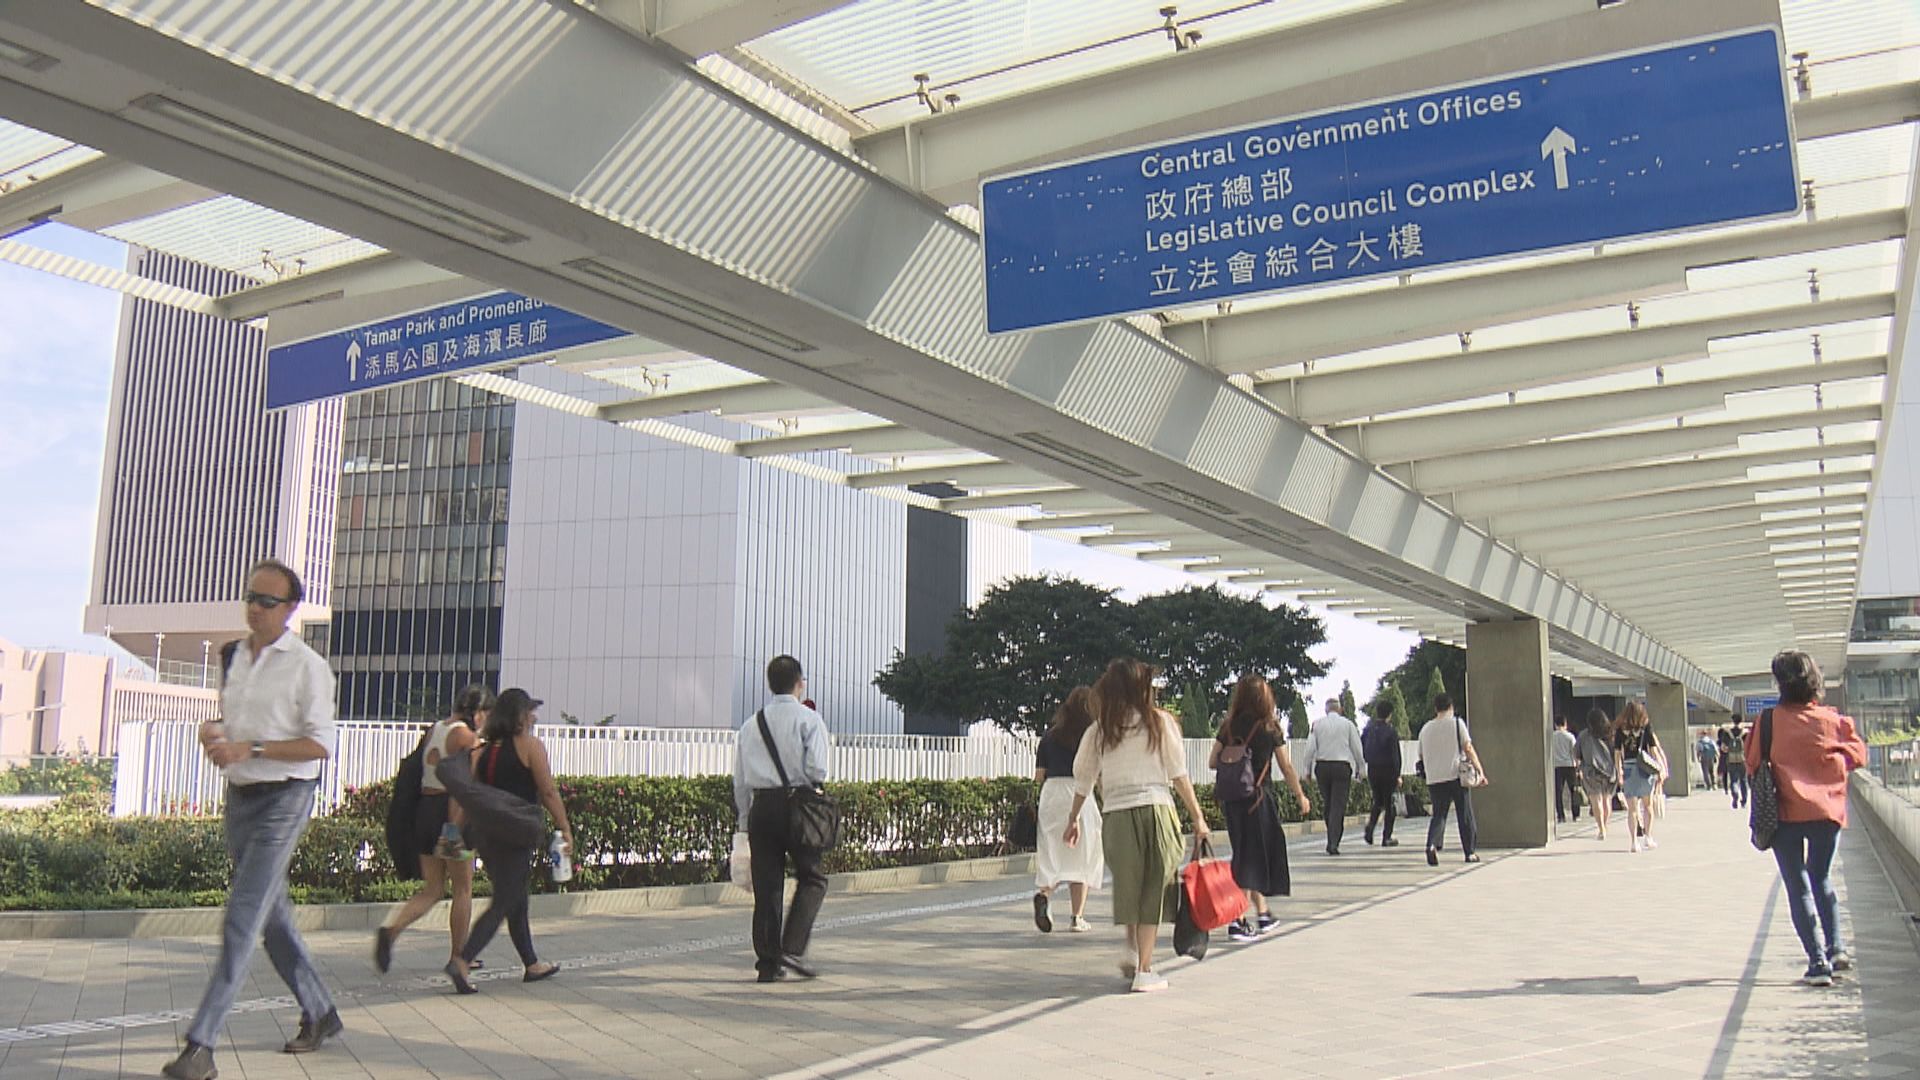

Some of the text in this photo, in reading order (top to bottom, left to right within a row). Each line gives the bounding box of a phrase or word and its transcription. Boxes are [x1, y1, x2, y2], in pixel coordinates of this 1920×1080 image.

[1141, 90, 1522, 178] Central Government Offices
[1145, 167, 1293, 221] 政府總部
[1146, 169, 1536, 252] Legislative Council Complex
[1150, 222, 1424, 296] 立法會綜合大樓
[364, 297, 546, 348] Tamar Park and Promenad
[364, 318, 547, 380] 添馬公園及海濱長廊
